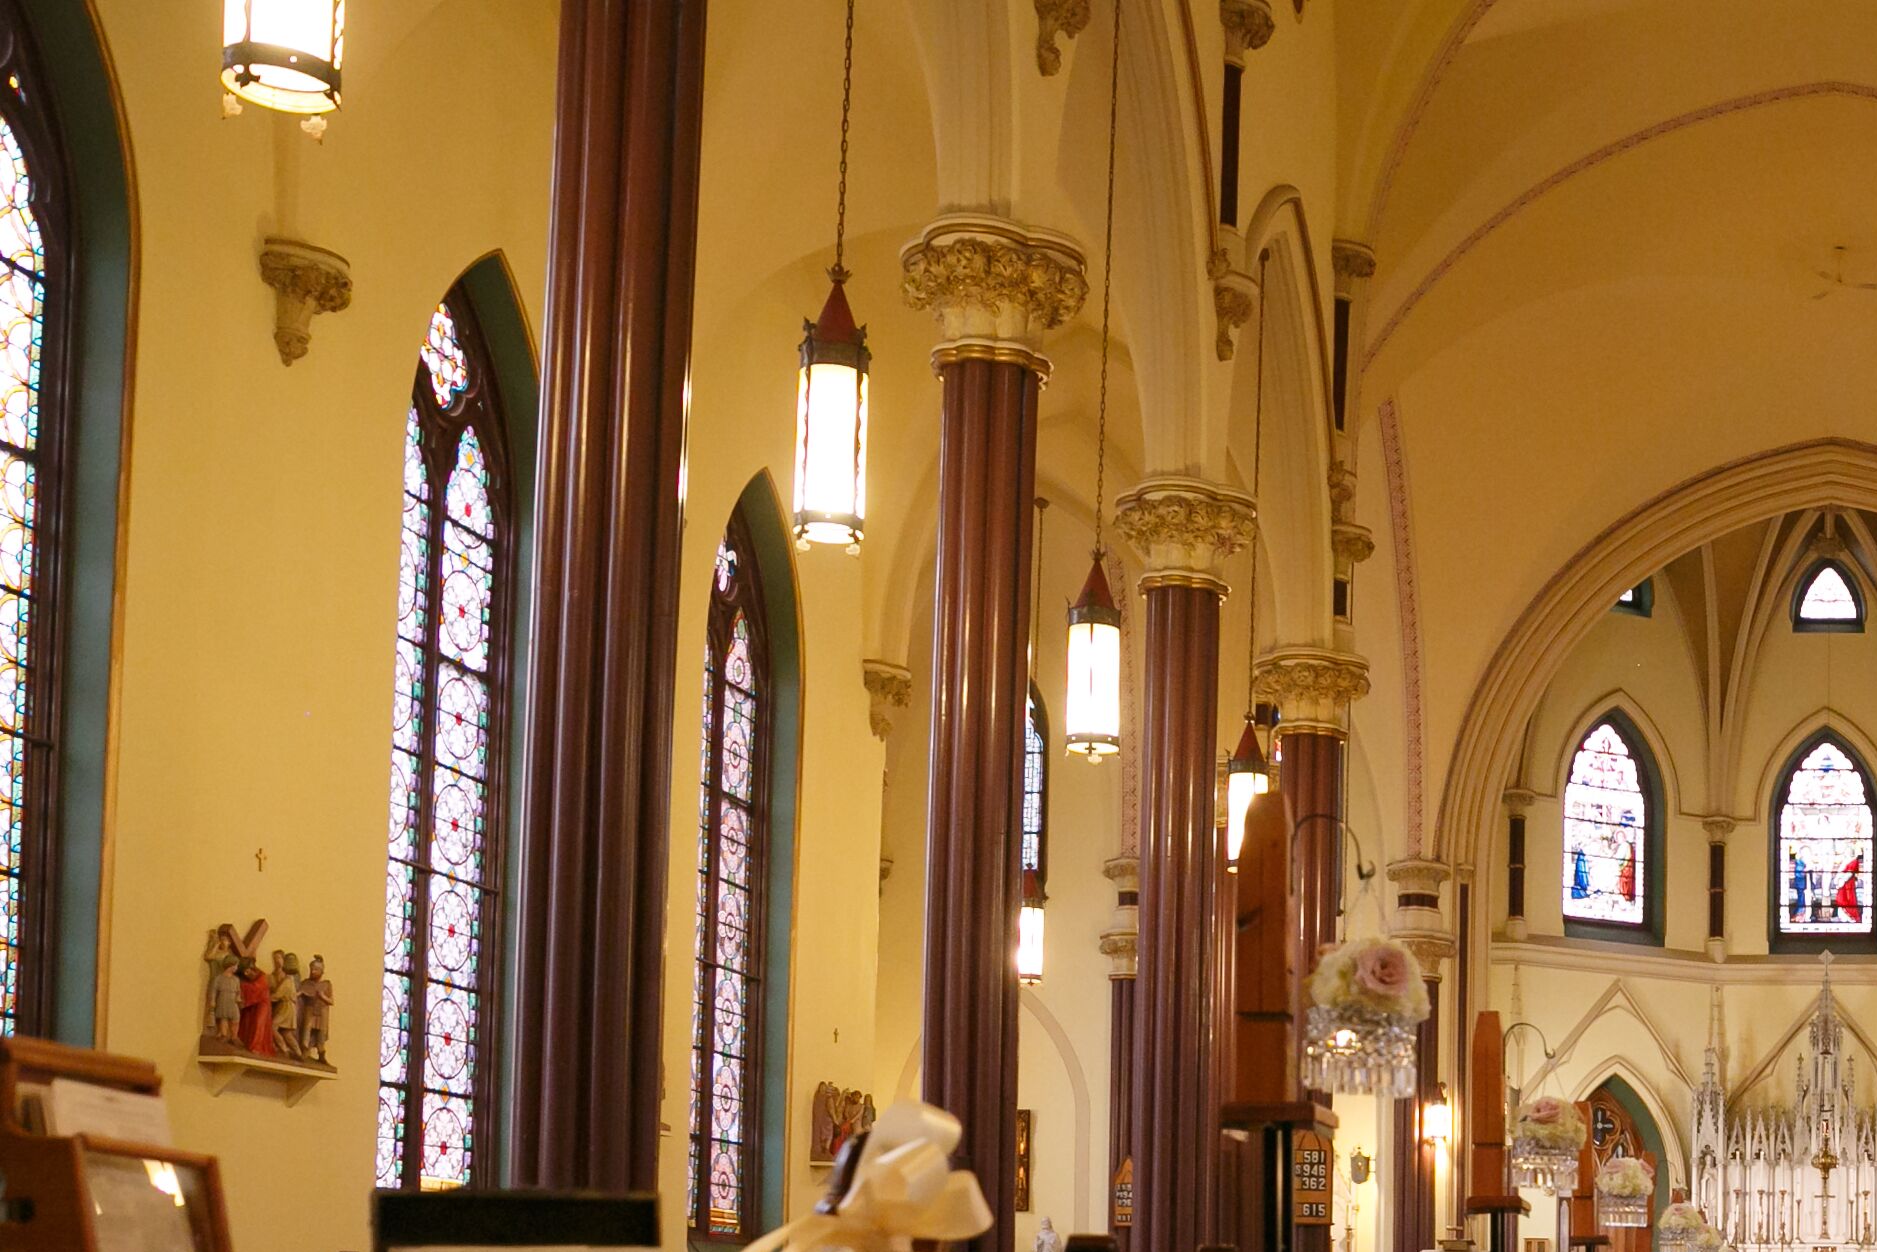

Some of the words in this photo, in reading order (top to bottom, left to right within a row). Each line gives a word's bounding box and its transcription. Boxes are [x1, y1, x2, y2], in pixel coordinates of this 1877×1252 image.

[1303, 1151, 1325, 1163] 581
[1303, 1164, 1326, 1176] 946
[1302, 1178, 1326, 1190] 362
[1303, 1204, 1326, 1216] 615
